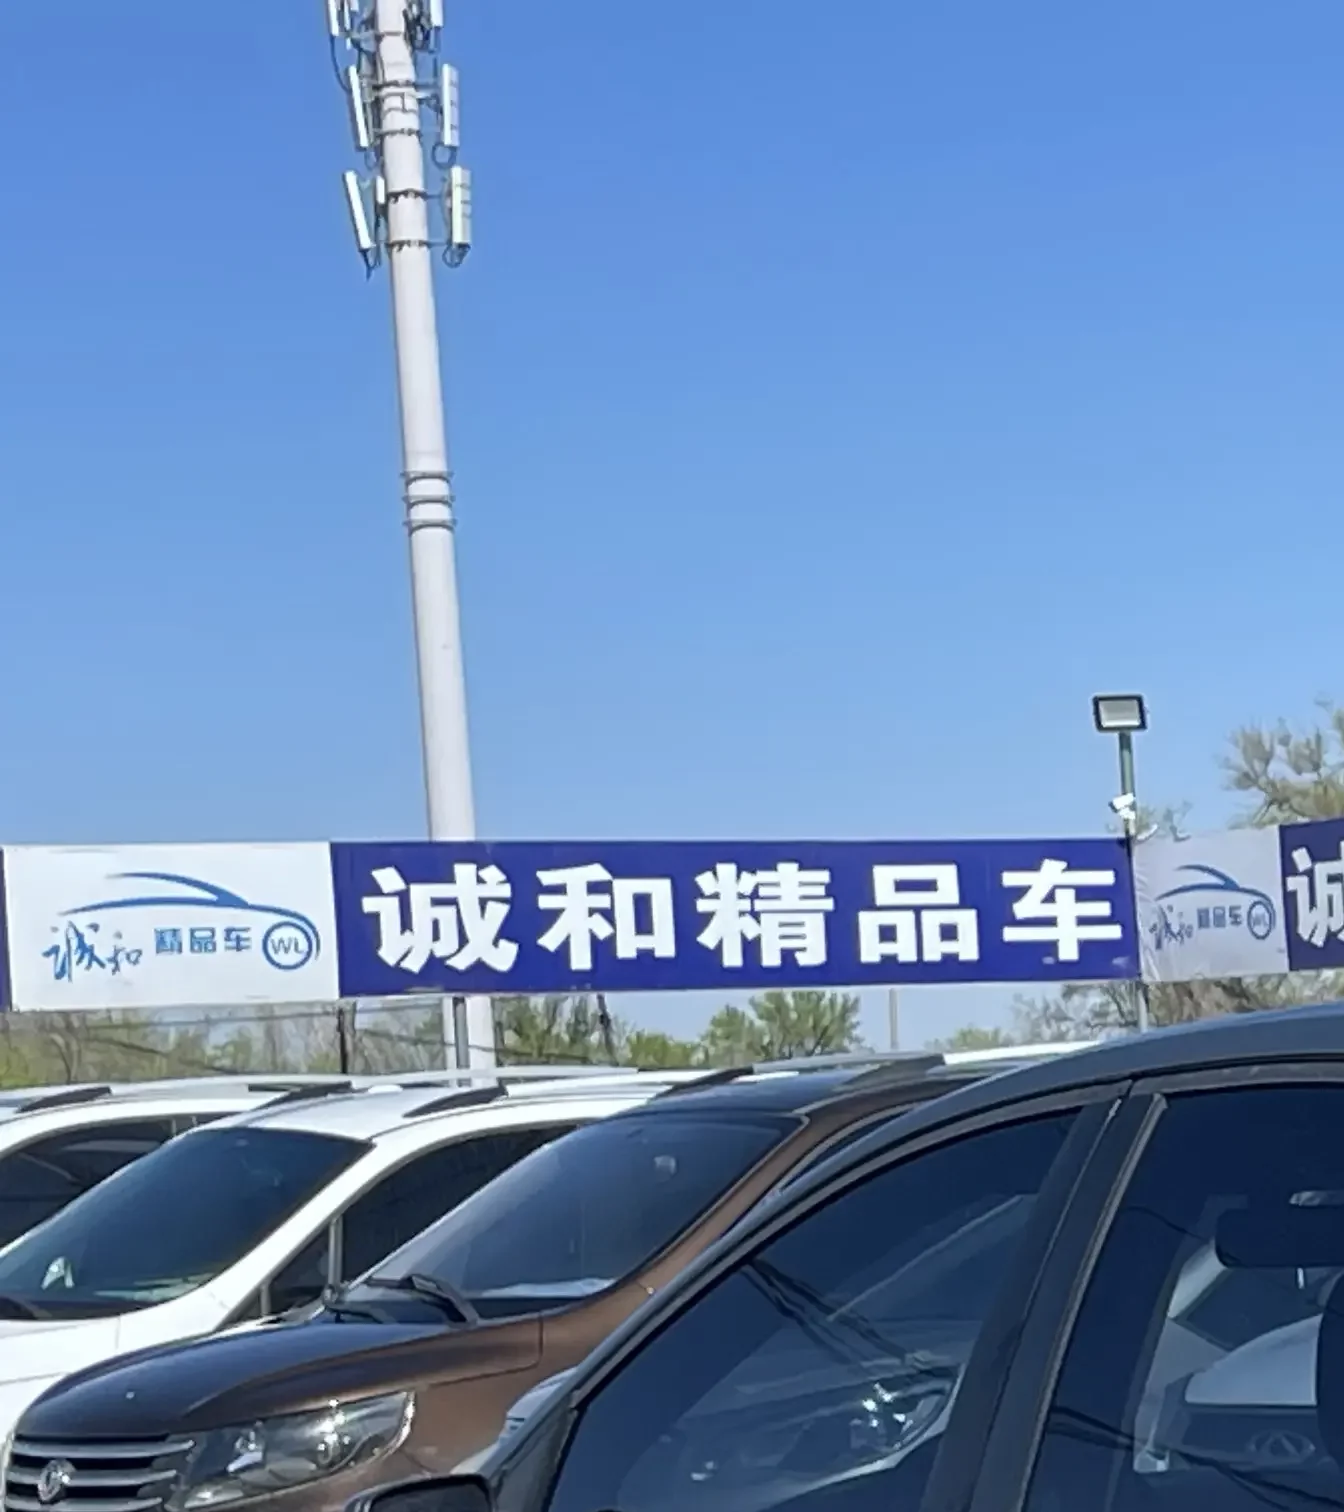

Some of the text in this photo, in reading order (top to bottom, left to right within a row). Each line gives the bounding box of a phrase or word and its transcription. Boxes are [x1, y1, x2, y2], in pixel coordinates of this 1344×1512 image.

[153, 926, 252, 955] 精品车
[361, 858, 1124, 974] 诚和精品车
